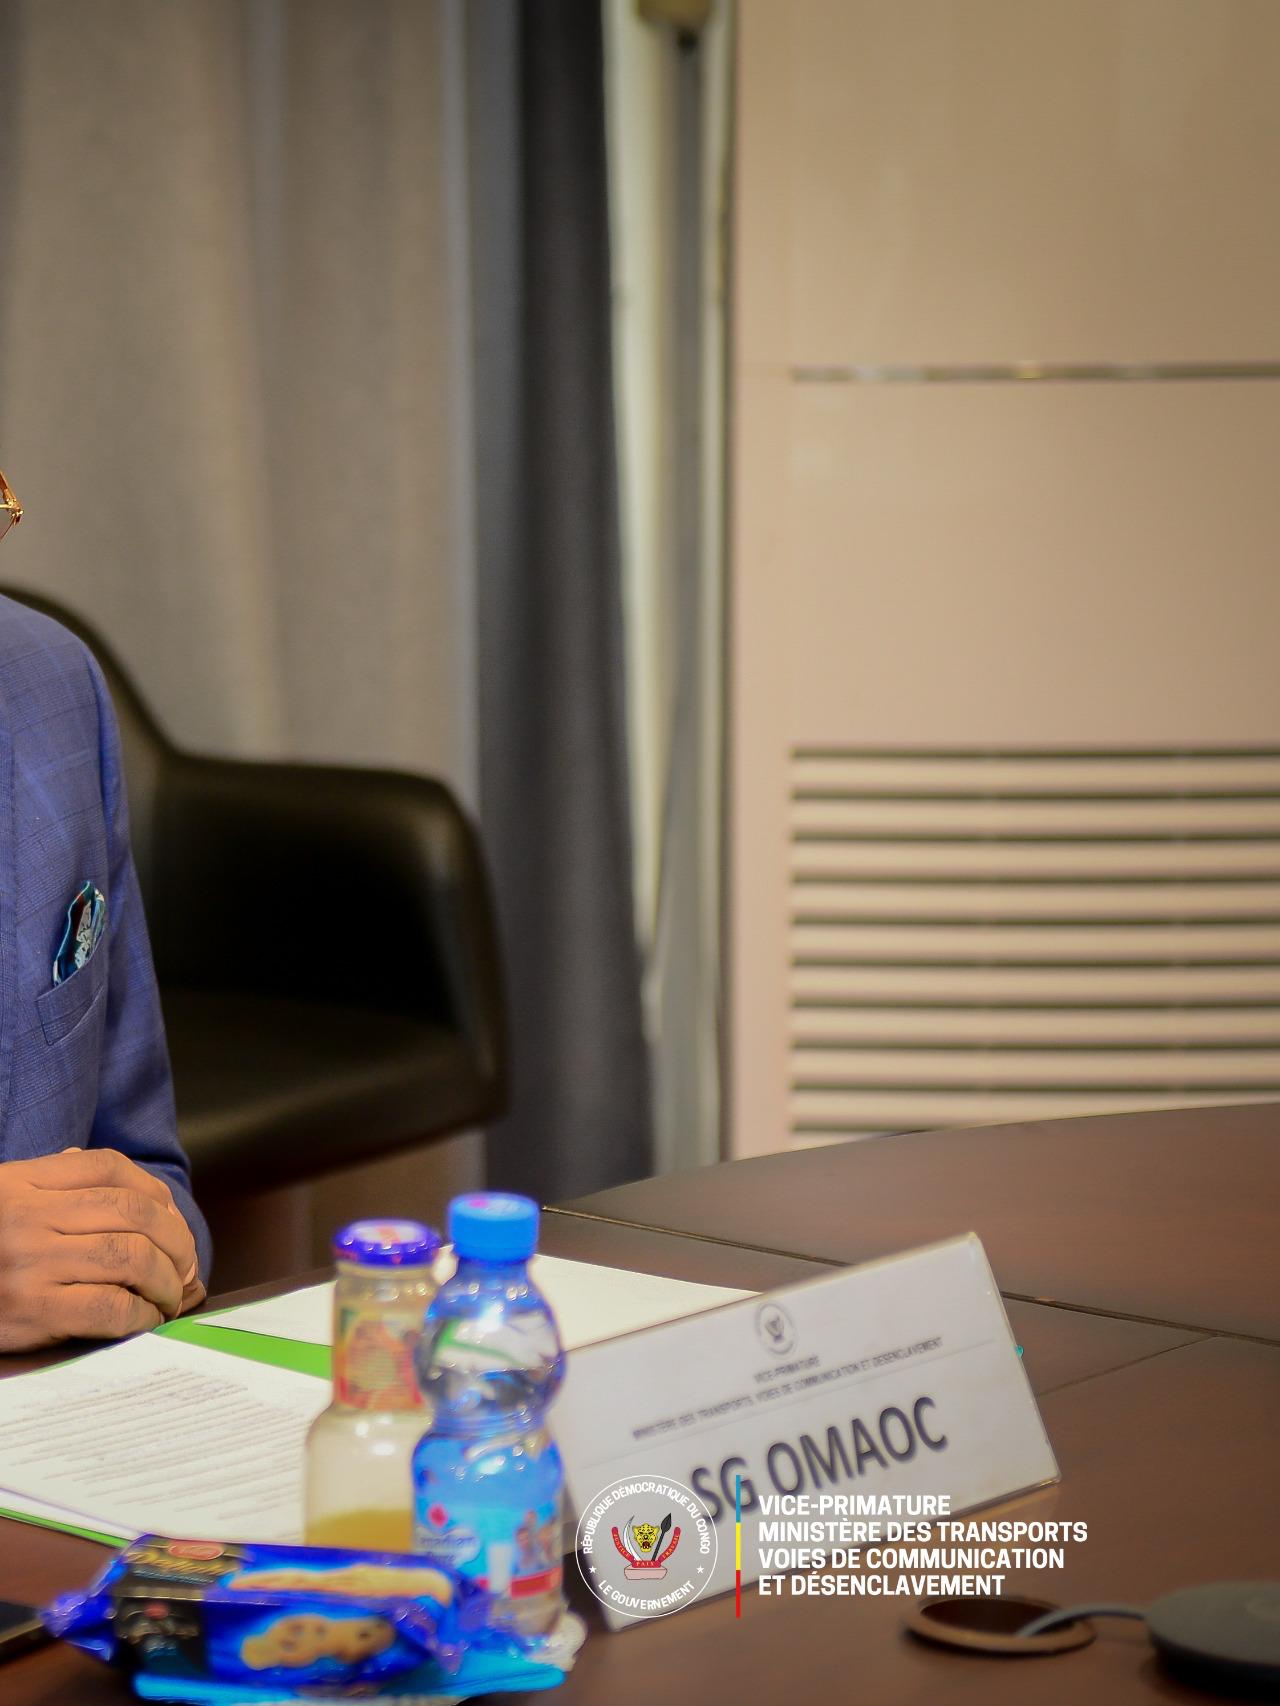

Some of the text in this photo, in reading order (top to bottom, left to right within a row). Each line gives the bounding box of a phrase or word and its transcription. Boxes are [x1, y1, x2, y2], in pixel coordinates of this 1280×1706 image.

[794, 1362, 862, 1392] COMMUNICATION
[691, 1395, 948, 1525] SG OMAOC
